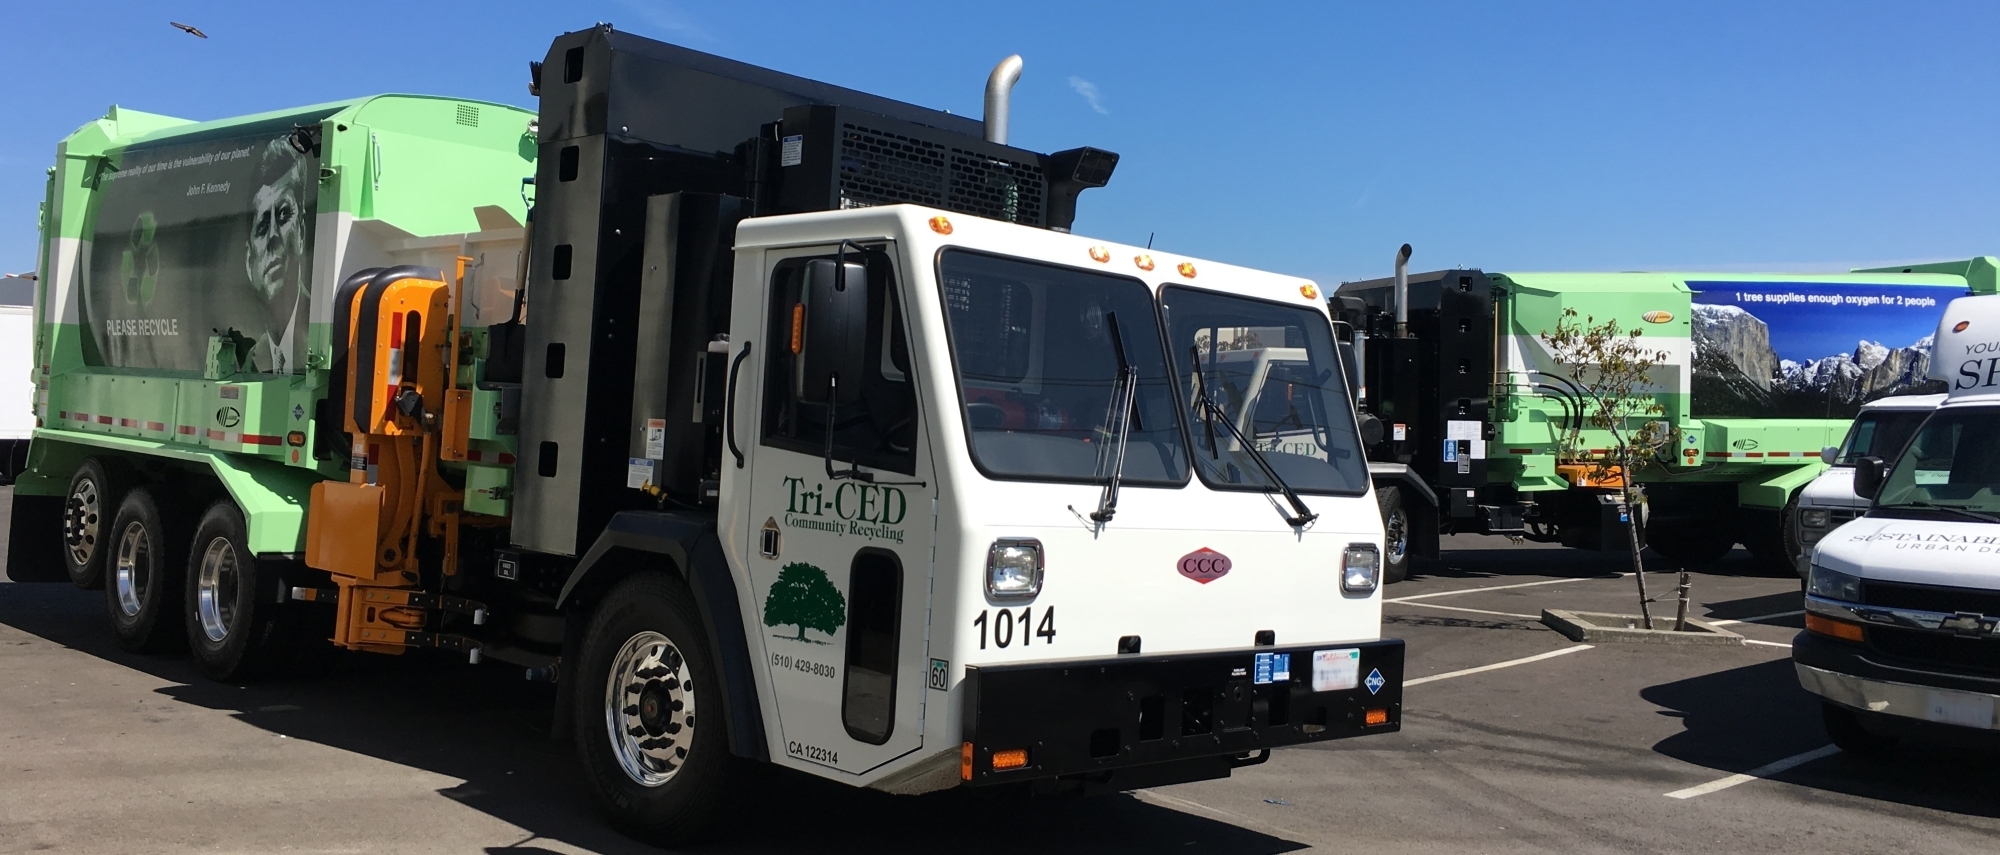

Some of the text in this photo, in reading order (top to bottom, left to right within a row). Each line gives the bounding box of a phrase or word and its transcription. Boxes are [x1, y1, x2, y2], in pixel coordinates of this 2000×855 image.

[128, 165, 142, 177] reality
[142, 163, 149, 174] of
[148, 164, 157, 173] our
[157, 160, 168, 171] time
[168, 159, 174, 170] is
[173, 157, 182, 169] the
[183, 152, 214, 166] vulnerability
[214, 150, 221, 162] of
[221, 151, 231, 161] our
[187, 180, 231, 196] John F. Kennedy
[1735, 292, 1937, 308] 1 tree supplies enough oxygen for 2 people
[106, 318, 179, 336] PLEASE RECYCLE
[1965, 341, 2000, 355] YOU
[782, 475, 907, 525] Tri-CED
[784, 512, 904, 544] Community Recycling
[1895, 542, 1968, 552] URBAN
[1183, 558, 1225, 574] CCC
[973, 605, 1057, 650] 1014
[771, 652, 836, 679] (510) 429-8030
[931, 666, 946, 688] 60
[1367, 677, 1382, 686] CNG
[789, 740, 839, 765] CA 122314
